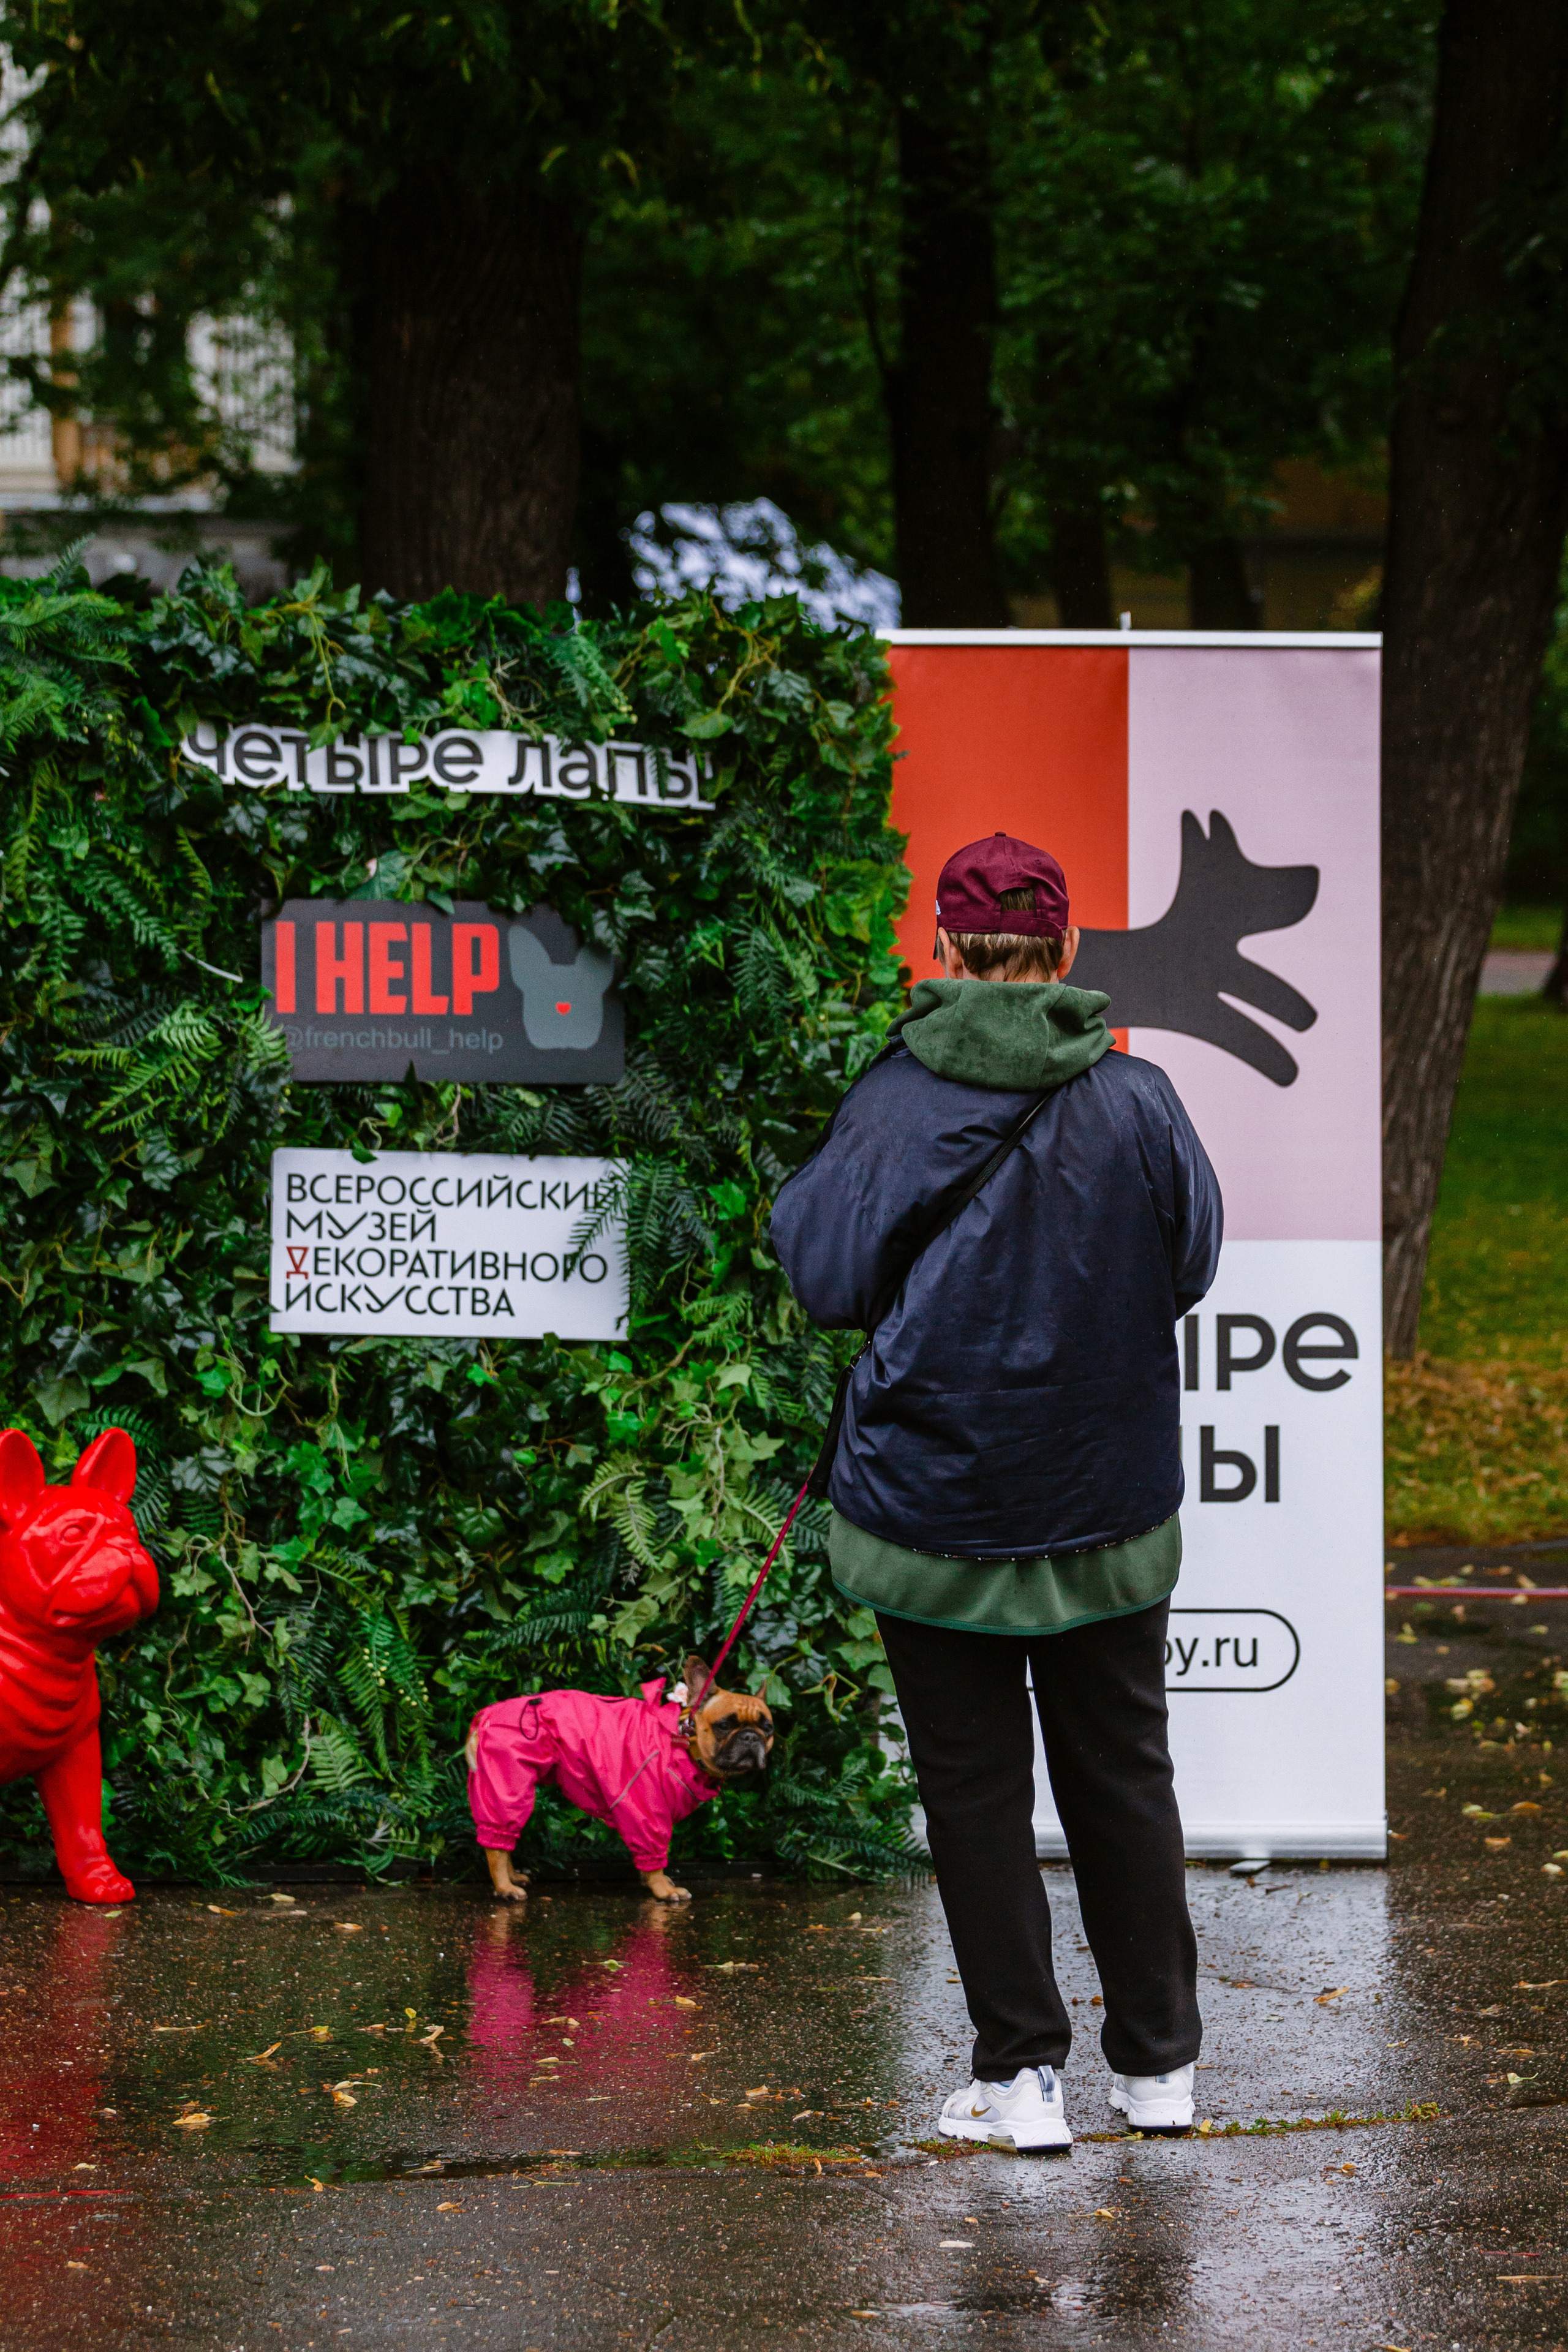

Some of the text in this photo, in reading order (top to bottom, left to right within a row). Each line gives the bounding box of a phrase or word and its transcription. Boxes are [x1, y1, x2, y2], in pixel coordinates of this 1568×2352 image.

[276, 921, 500, 1016] I HELP
[286, 1208, 437, 1243] МУЗЕЙ
[285, 1246, 608, 1284] ДЕКОРАТИВНОГО
[285, 1282, 516, 1317] ИСКУССТВА
